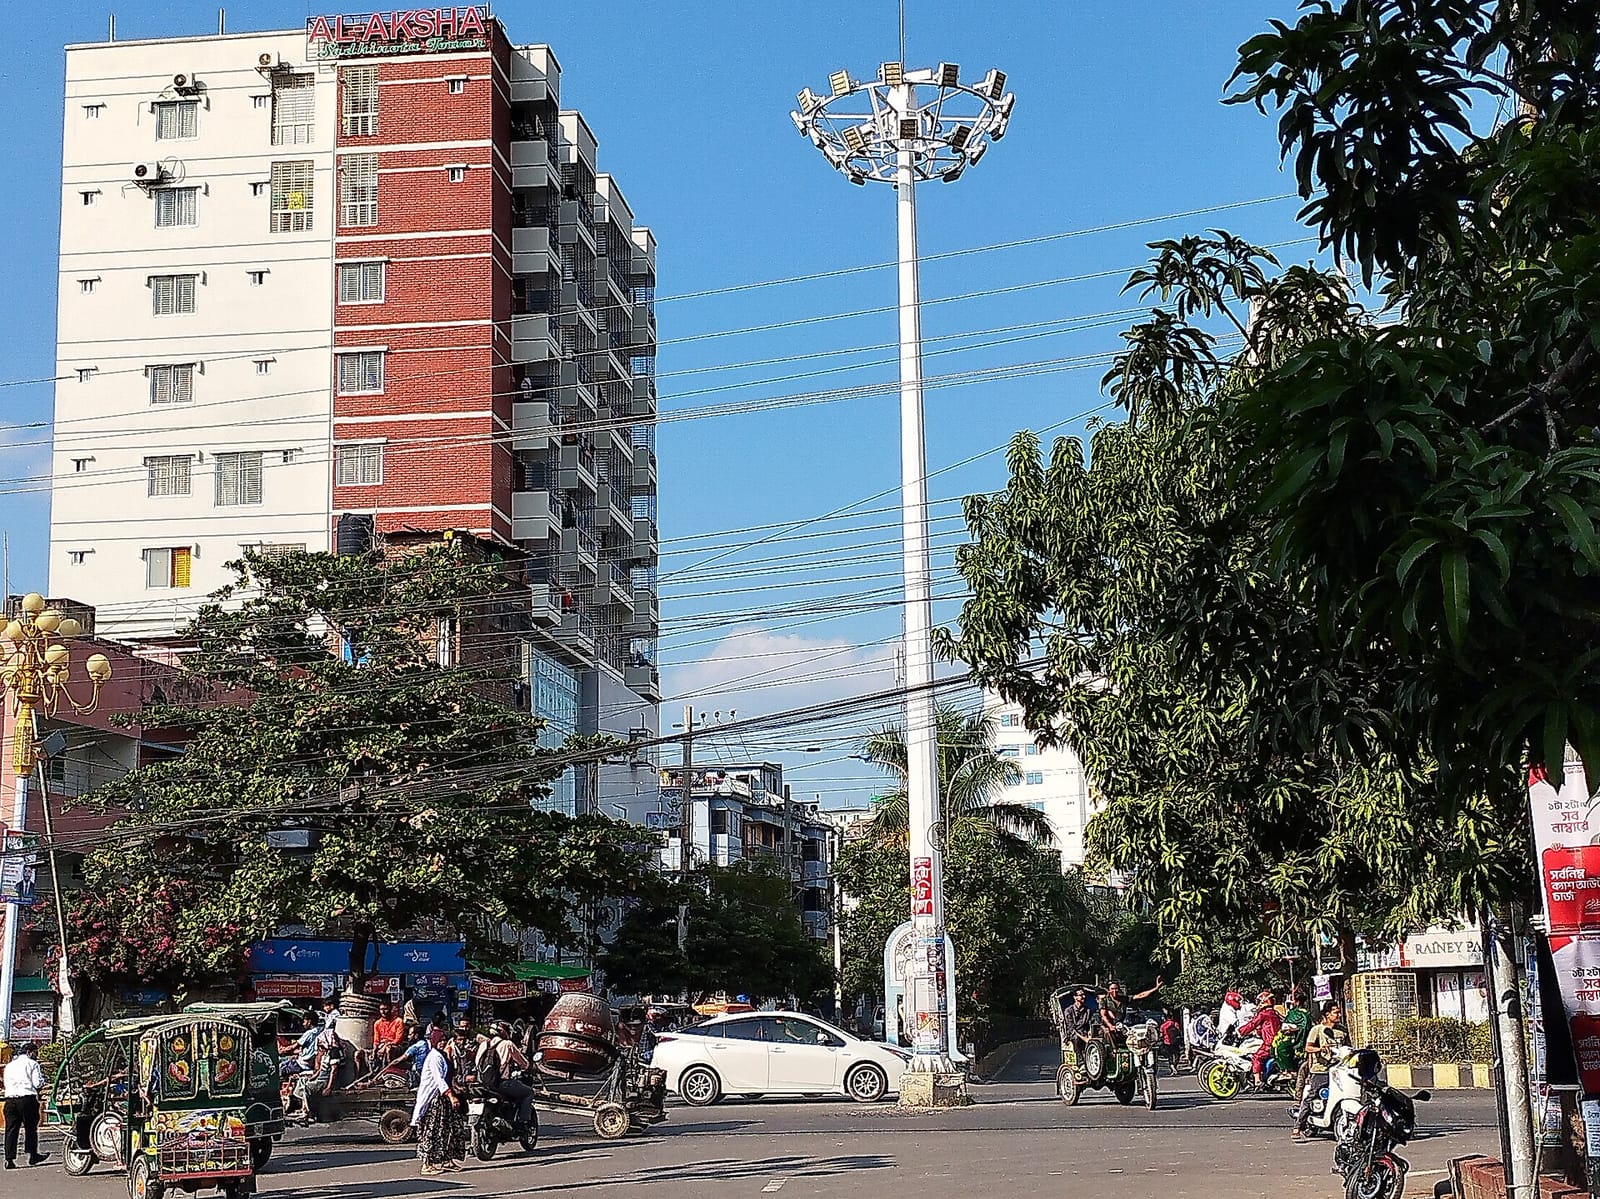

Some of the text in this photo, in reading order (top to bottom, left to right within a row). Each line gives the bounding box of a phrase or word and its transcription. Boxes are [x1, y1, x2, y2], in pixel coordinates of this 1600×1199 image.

[309, 7, 485, 43] AL-AKSHA
[1561, 811, 1579, 821] সব
[1415, 941, 1483, 954] RAINEY PA
